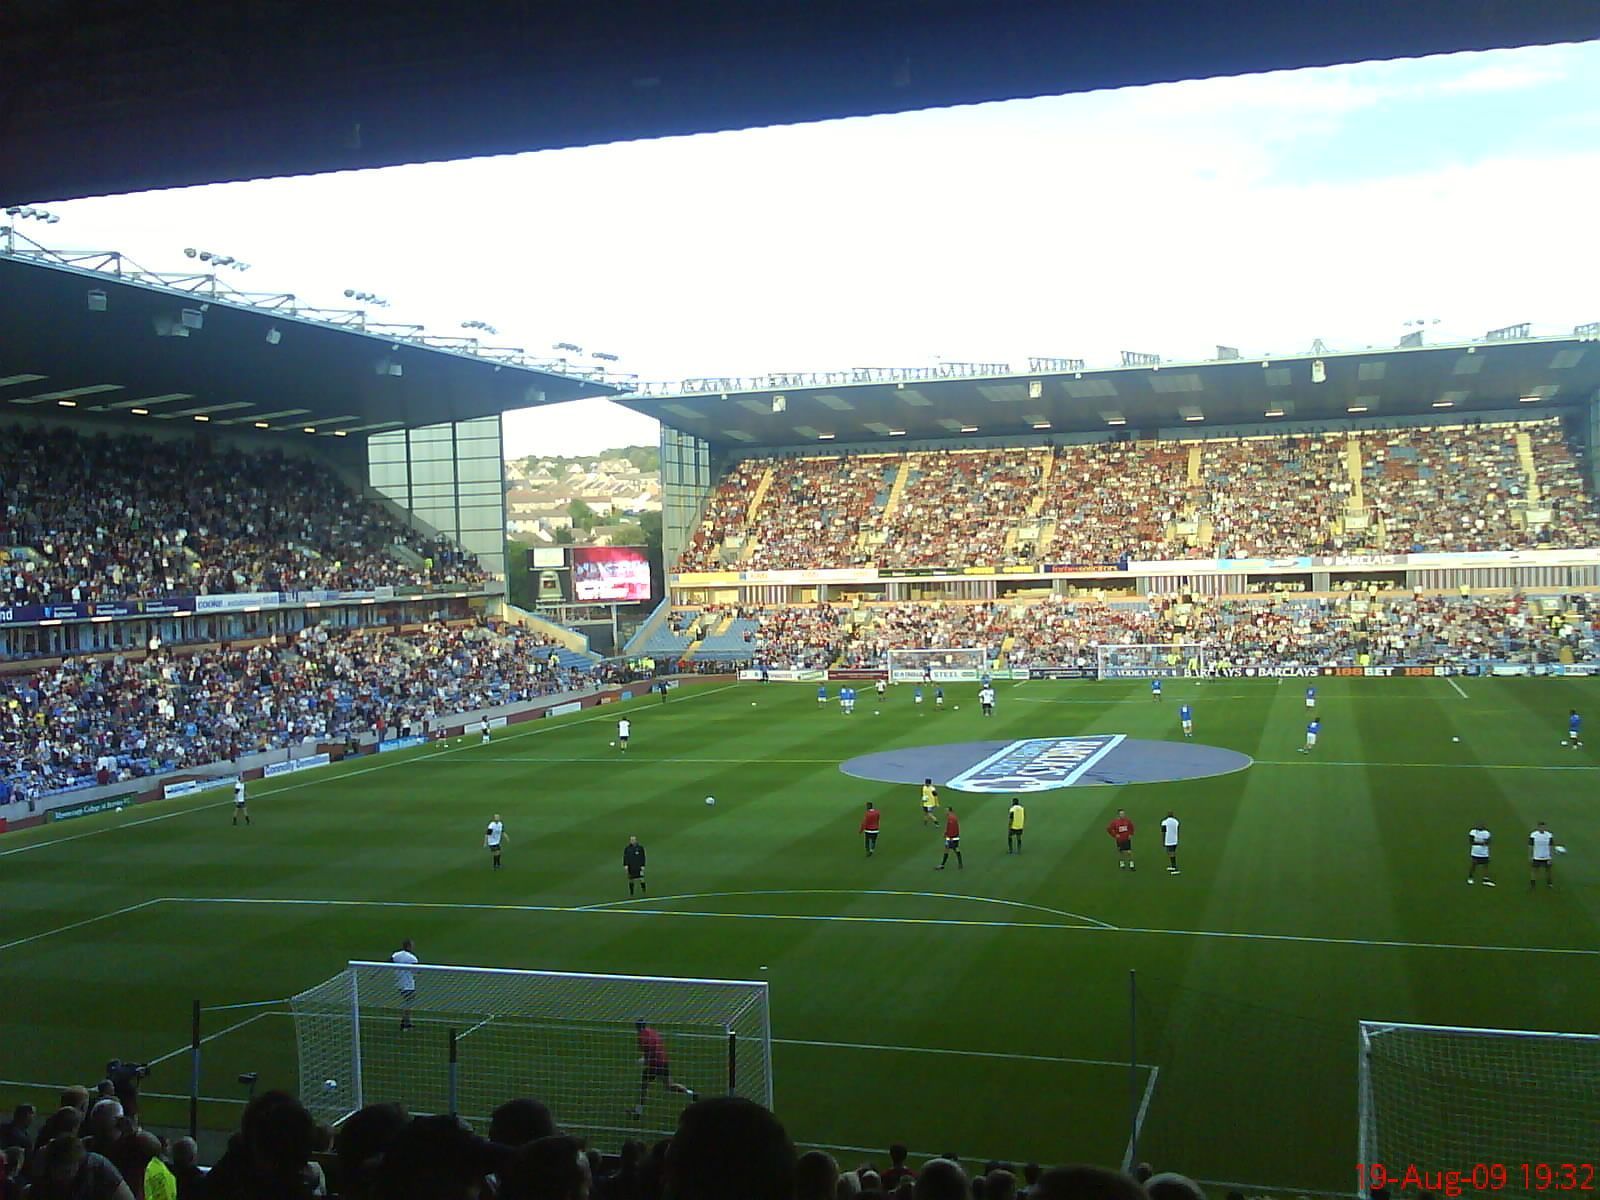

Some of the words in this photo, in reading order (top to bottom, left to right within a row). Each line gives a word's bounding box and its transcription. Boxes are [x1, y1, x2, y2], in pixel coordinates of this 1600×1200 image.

[1335, 555, 1395, 565] BARCLAYS
[1258, 667, 1318, 677] BARCLAYS
[1336, 667, 1394, 676] 188BET
